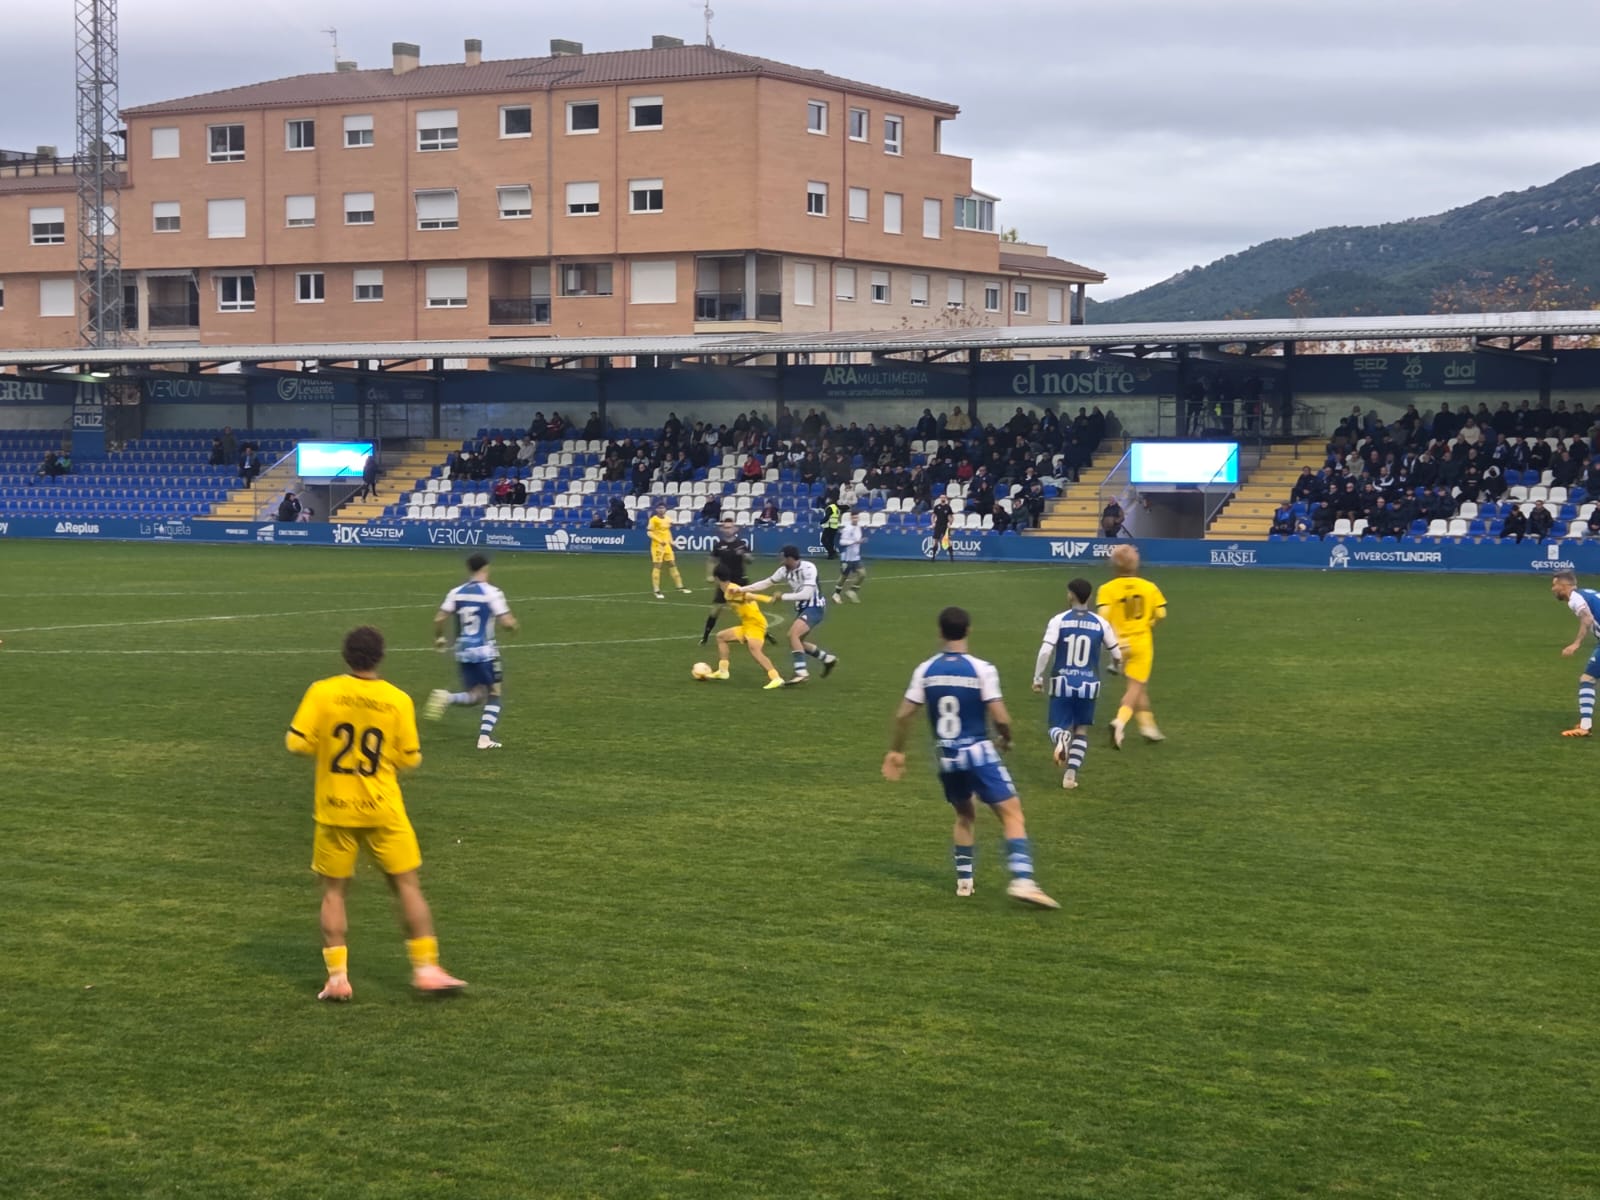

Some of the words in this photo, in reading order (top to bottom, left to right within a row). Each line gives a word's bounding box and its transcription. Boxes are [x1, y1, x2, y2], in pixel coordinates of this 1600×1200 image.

[1443, 360, 1476, 378] dial
[1012, 364, 1037, 394] el
[1041, 366, 1135, 394] nostre
[298, 384, 335, 395] Levante
[74, 415, 103, 427] RUIZ
[65, 522, 100, 535] Replus
[140, 522, 151, 535] La
[360, 527, 404, 538] SYSTEM
[428, 528, 483, 545] VERICAT
[569, 533, 625, 545] Tecnovasol
[1210, 551, 1257, 566] BARSEL
[1063, 633, 1091, 668] 10
[936, 695, 962, 739] 8
[330, 722, 384, 778] 29
